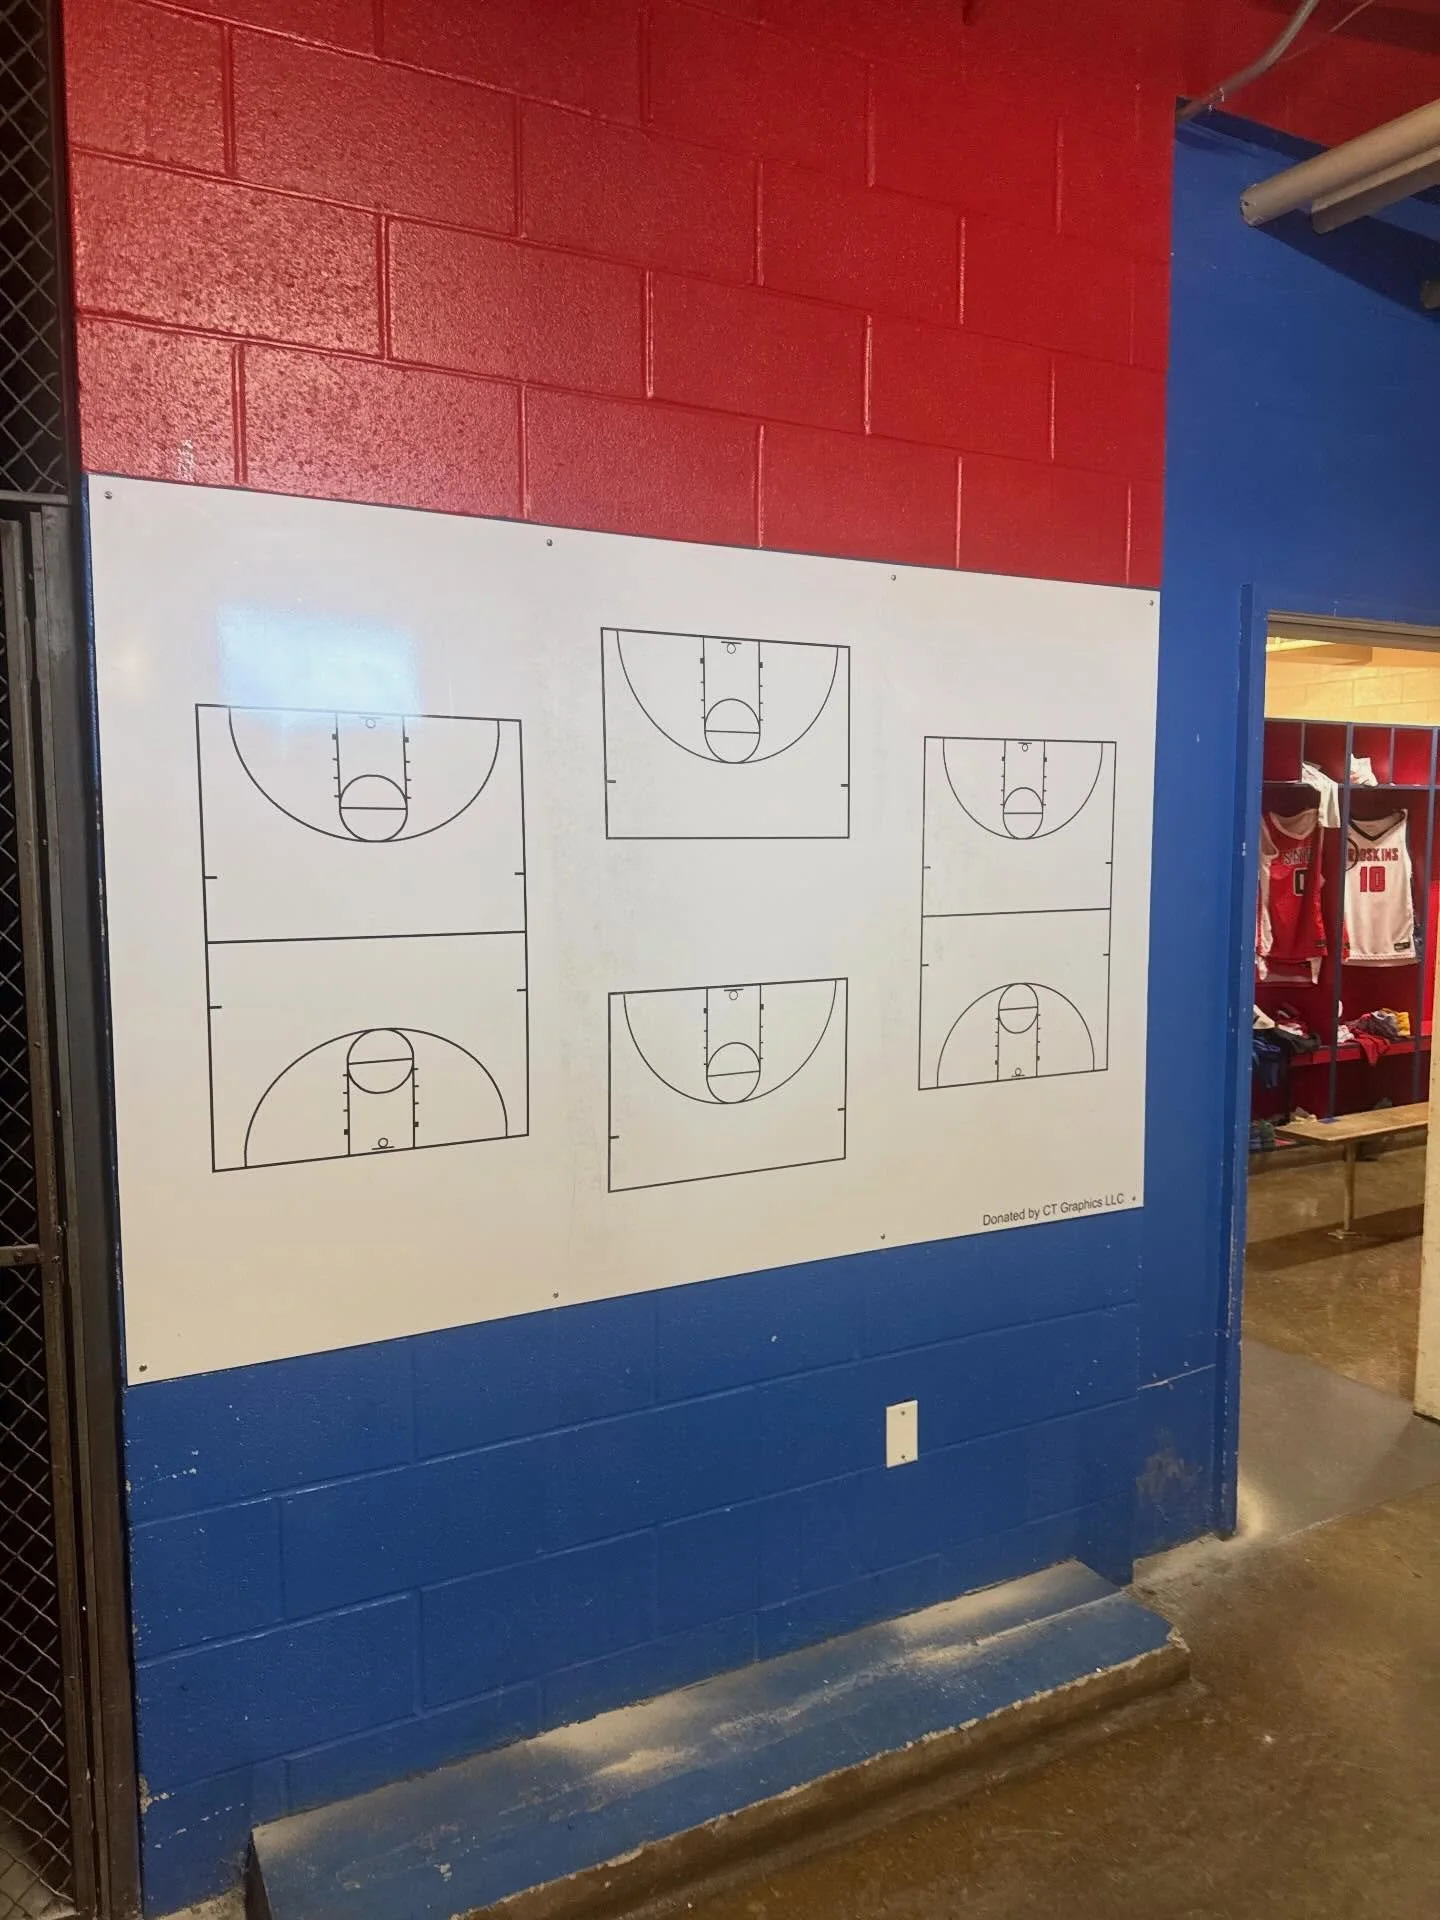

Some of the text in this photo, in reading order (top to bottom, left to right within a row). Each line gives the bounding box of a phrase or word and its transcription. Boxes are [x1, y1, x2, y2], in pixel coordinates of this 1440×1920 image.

[1360, 866, 1385, 893] 10
[983, 1193, 1124, 1226] Donated by CT Graphics LLC
